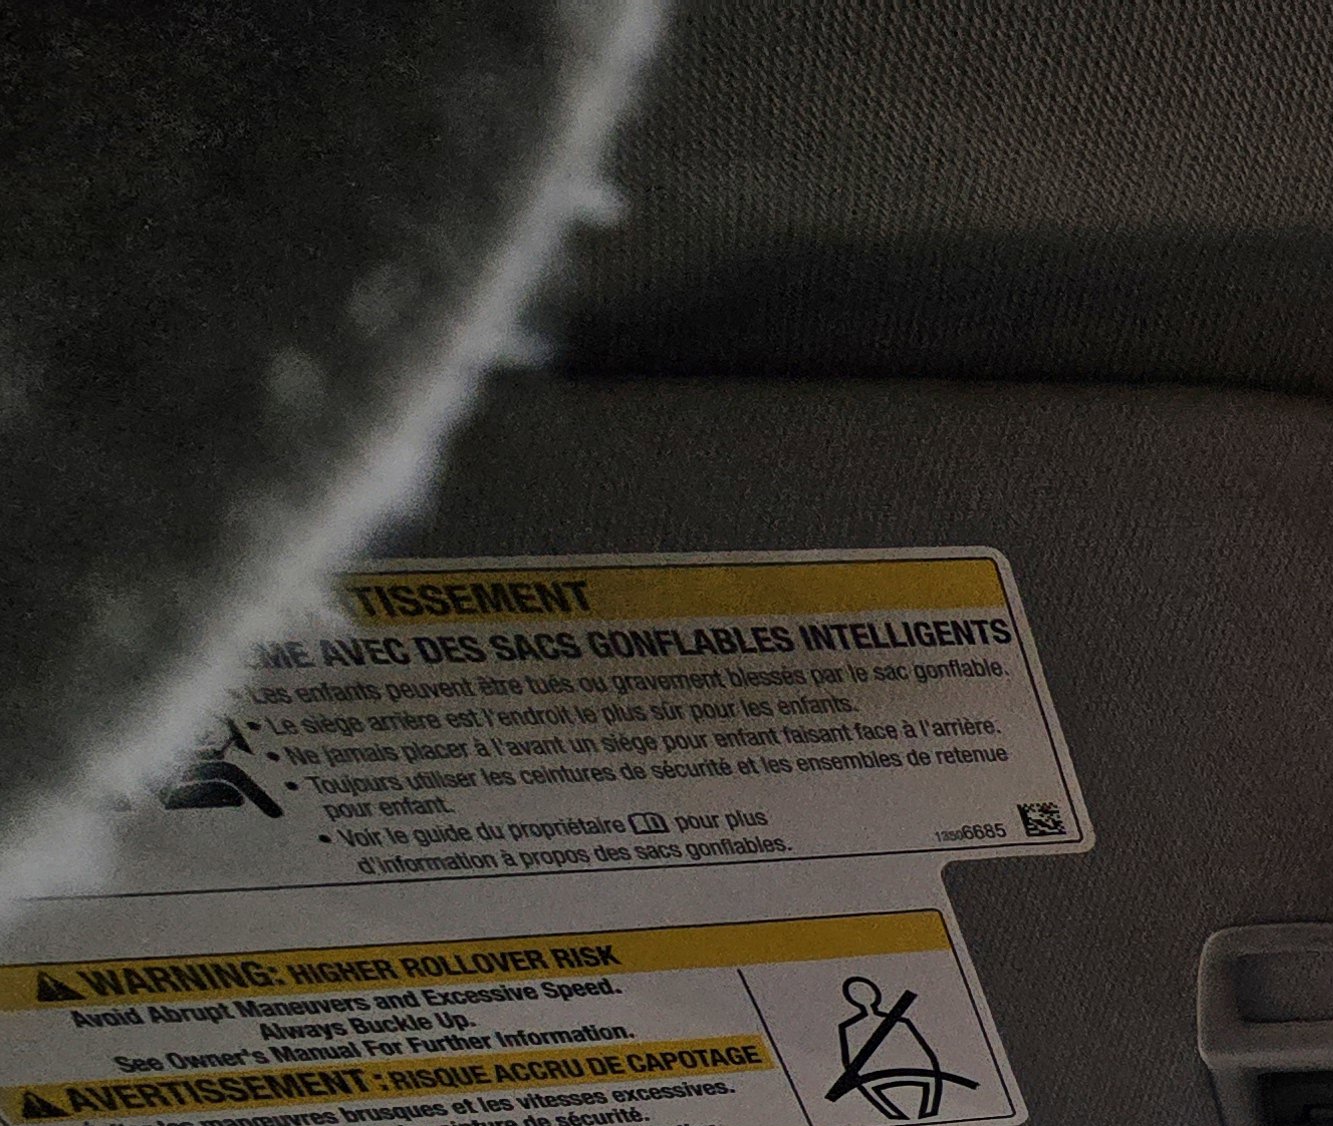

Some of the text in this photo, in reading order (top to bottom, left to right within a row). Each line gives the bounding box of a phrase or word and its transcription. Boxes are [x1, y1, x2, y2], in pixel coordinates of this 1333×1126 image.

[349, 581, 589, 618] TISSEMENT
[320, 636, 410, 667] AVEC
[418, 634, 486, 664] DES
[490, 630, 583, 662] SACS
[587, 623, 795, 658] GONFLABLES
[801, 616, 1011, 651] INTELLIGENTS
[297, 681, 381, 701] enfants
[386, 677, 475, 701] peuvent
[477, 675, 522, 695] être
[525, 673, 578, 693] tués
[580, 675, 608, 691] ou
[612, 668, 723, 693] gravement
[727, 664, 804, 686] blessés
[811, 666, 844, 686] par
[850, 662, 869, 681] le
[874, 664, 910, 680] sac
[914, 657, 1009, 683] gonflable.
[267, 693, 859, 736] Le siège arrière est l'endroit le plus sûr pour les enfants.
[285, 715, 1002, 768] Ne jamais placer à l'avant un siège pour enfant faisant face à l'arrière.
[309, 745, 1009, 797] Toujours utiliser les ceintures de sécurité et les ensembles de retenue
[325, 794, 455, 820] pour enfant.
[338, 807, 769, 848] Voir le guide du propriétaire pour plus
[359, 833, 792, 875] d'information à propos des sacs gonflables.
[80, 944, 621, 999] WARNING: HIGHER ROLLOVER RISK
[72, 977, 622, 1028] Avoid Abrupt Maneuvers and Excessive Speed.
[114, 1023, 635, 1073] See Owner's Manual For Further Information.
[260, 1011, 476, 1042] Always Buckle Up.
[388, 1063, 493, 1090] RISQUE
[494, 1057, 586, 1083] ACCRU
[586, 1054, 626, 1076] DE
[627, 1044, 762, 1073] CAPOTAGE
[340, 1100, 449, 1122] brusques
[451, 1096, 475, 1114] et
[477, 1094, 514, 1112] les
[516, 1088, 608, 1109] vitesses
[612, 1079, 735, 1102] excessives.
